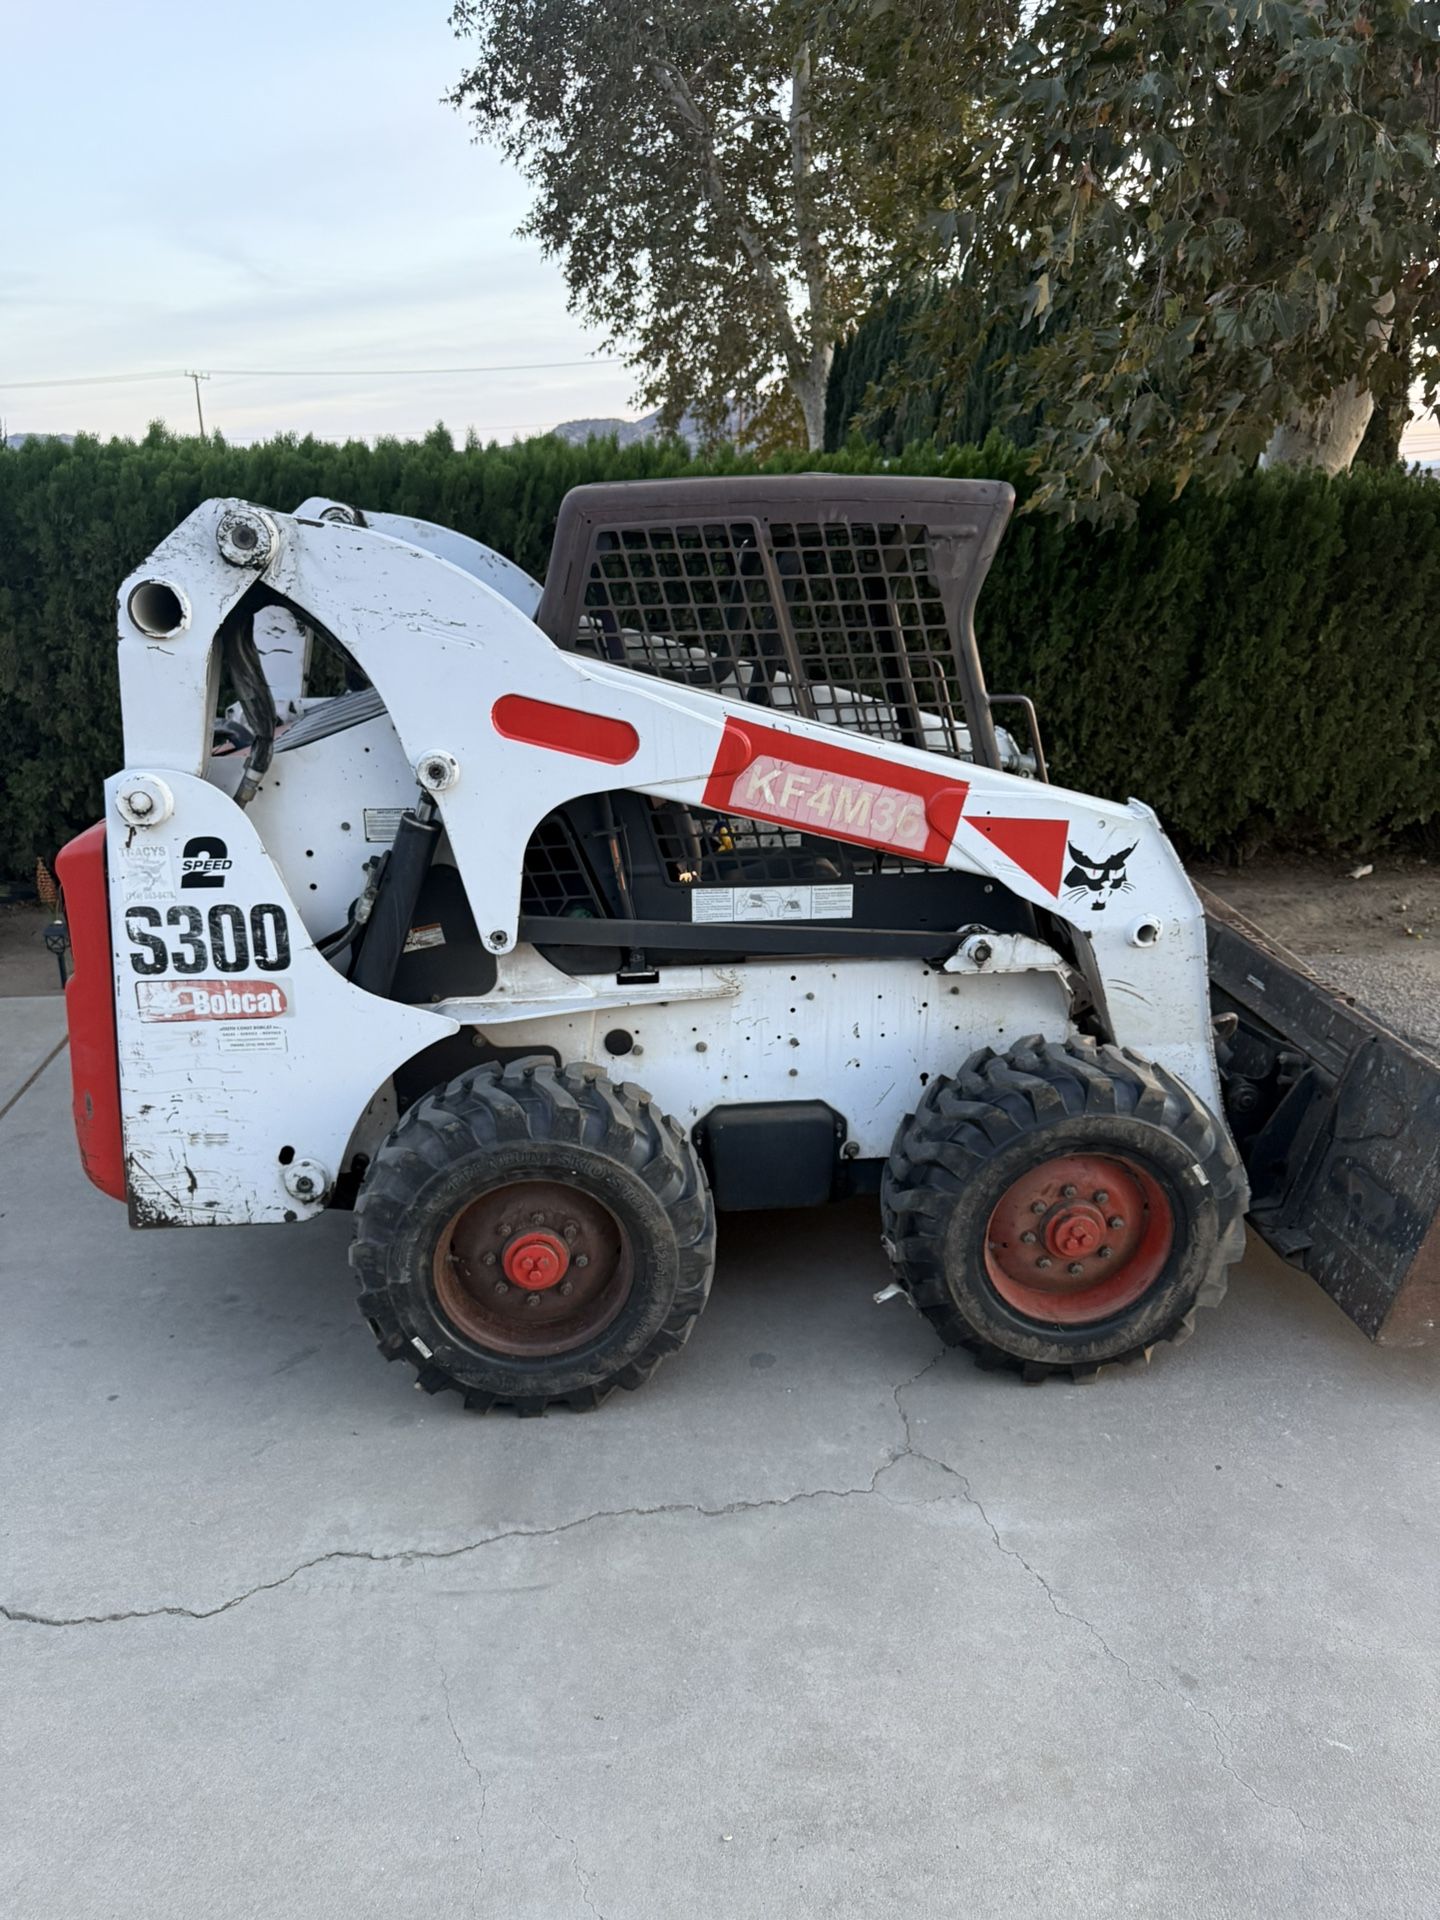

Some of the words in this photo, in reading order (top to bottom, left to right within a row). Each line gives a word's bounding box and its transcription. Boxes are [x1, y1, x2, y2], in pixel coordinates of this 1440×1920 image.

[180, 836, 228, 889] 2
[182, 859, 233, 871] SPEED
[125, 903, 292, 976] S300
[191, 988, 283, 1016] Bobcat
